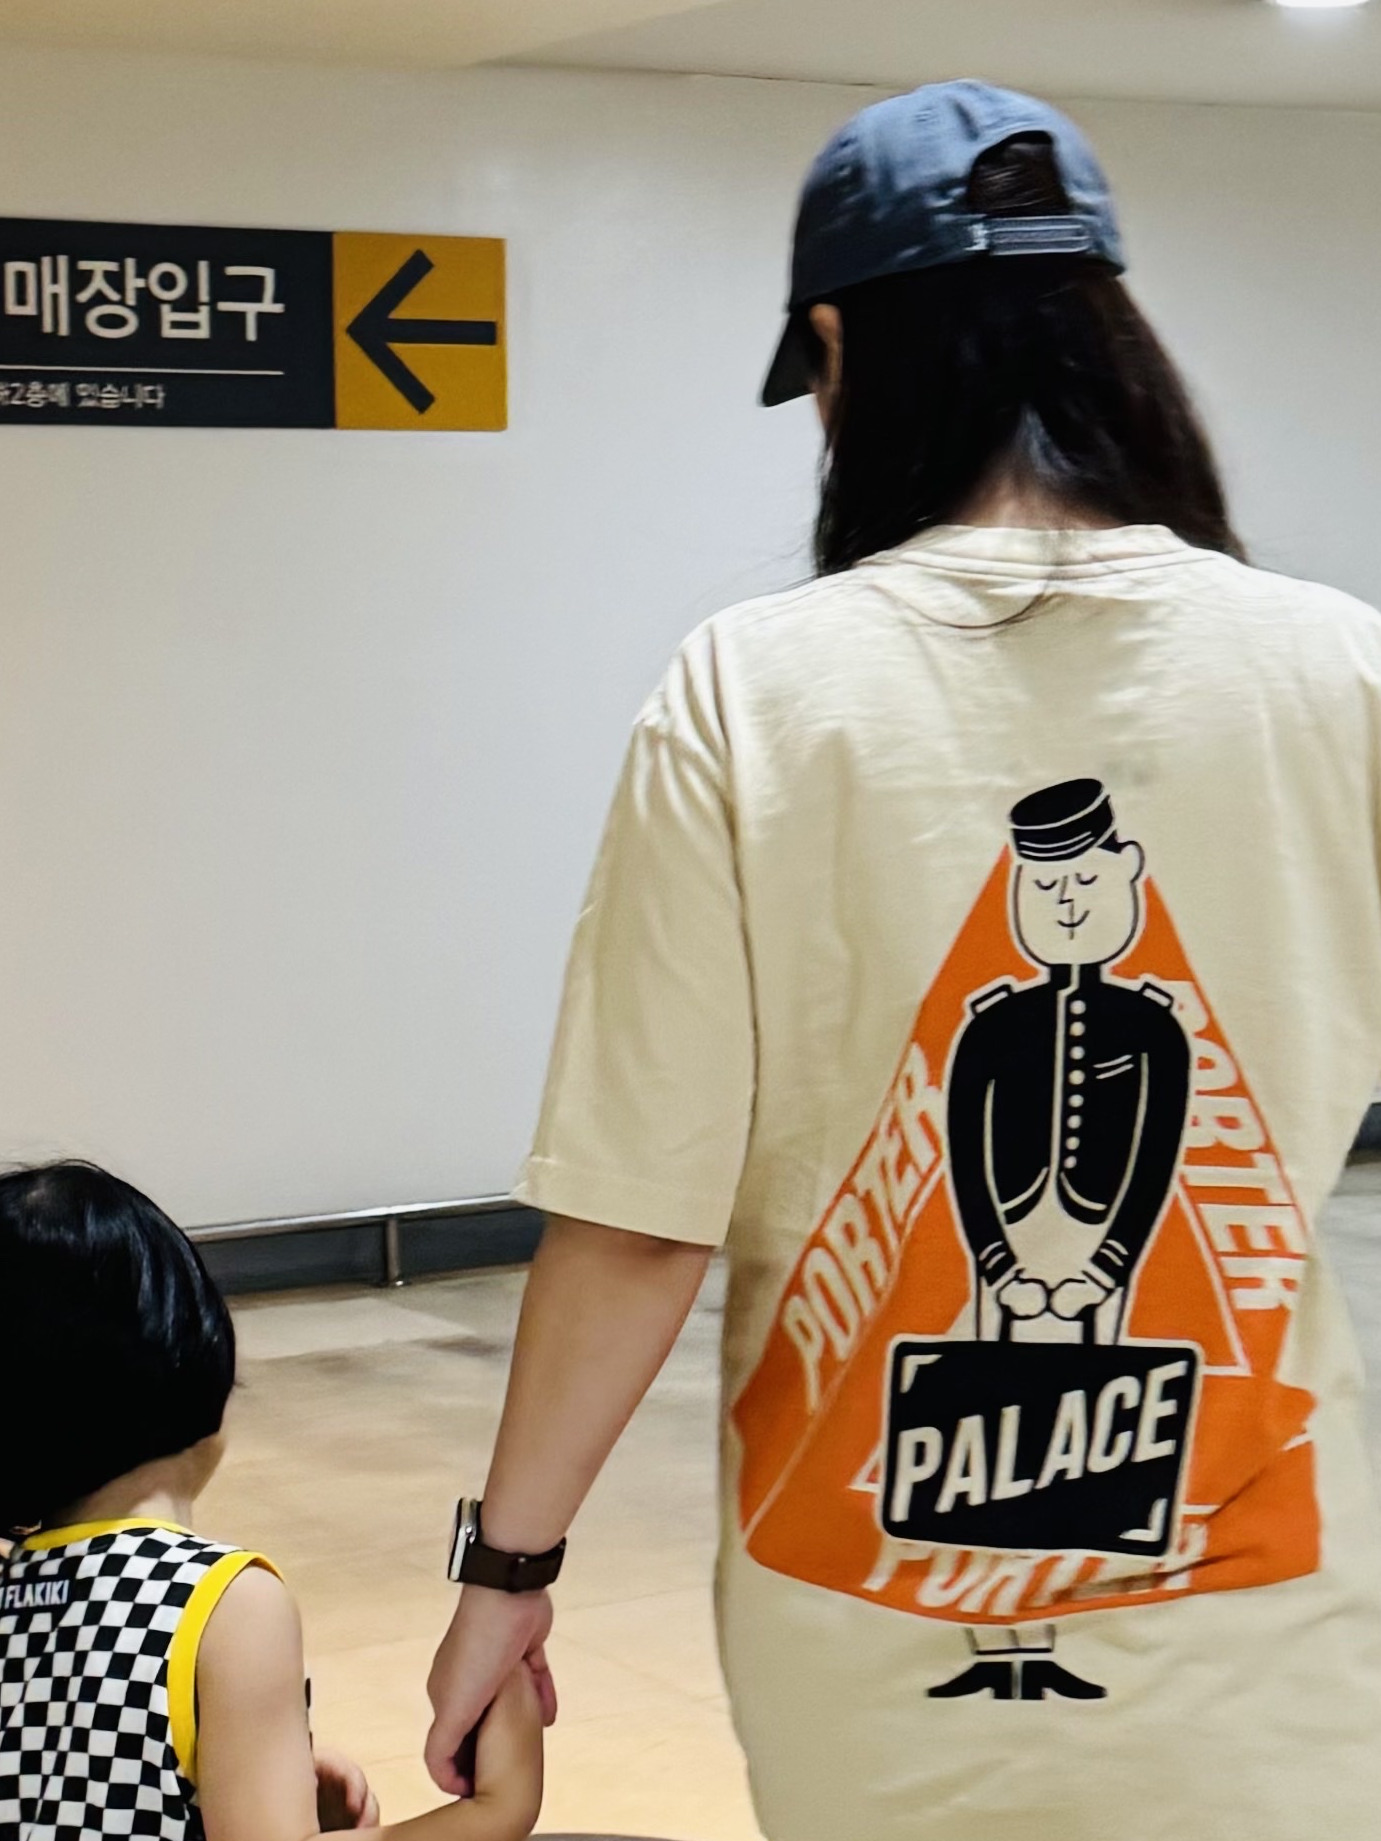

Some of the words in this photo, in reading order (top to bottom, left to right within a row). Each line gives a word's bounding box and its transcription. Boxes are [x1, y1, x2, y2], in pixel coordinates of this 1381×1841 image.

[4, 254, 285, 342] 매장입구
[75, 382, 166, 409] 있습니다
[783, 1042, 942, 1416] PORTER
[889, 1360, 1188, 1523] PALACE
